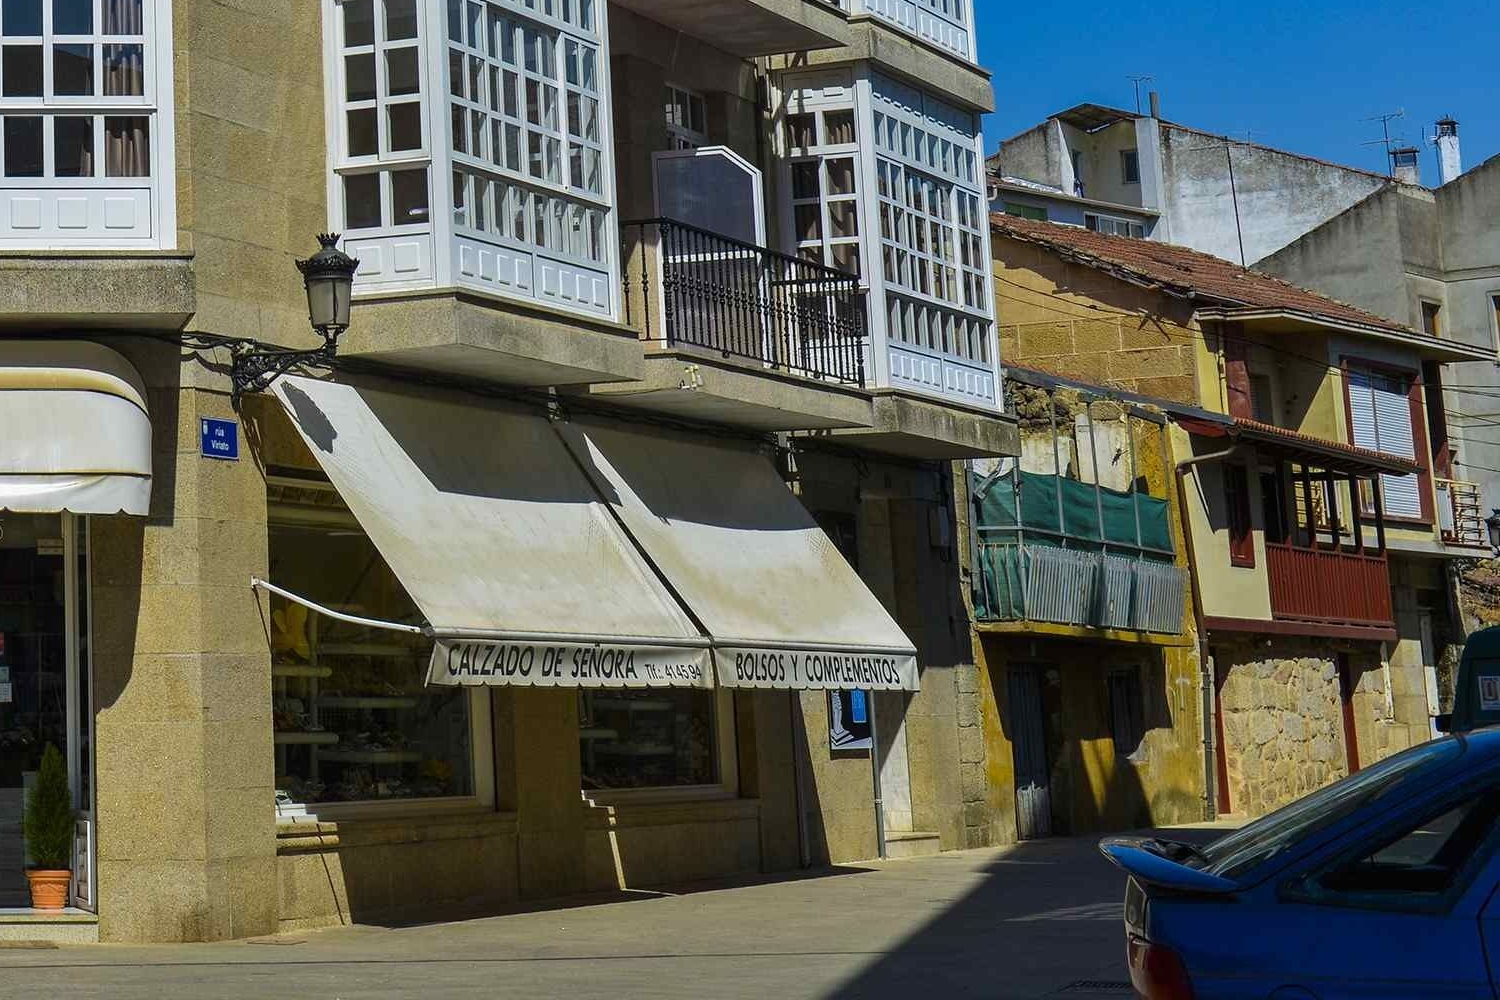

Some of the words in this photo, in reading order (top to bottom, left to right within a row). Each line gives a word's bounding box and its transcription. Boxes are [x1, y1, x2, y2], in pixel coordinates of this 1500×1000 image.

[447, 643, 534, 677] CALZADO
[541, 647, 562, 677] DE
[736, 653, 786, 682] BOLSOS
[789, 655, 798, 681] Y
[805, 655, 901, 684] COMPLEMENTOS
